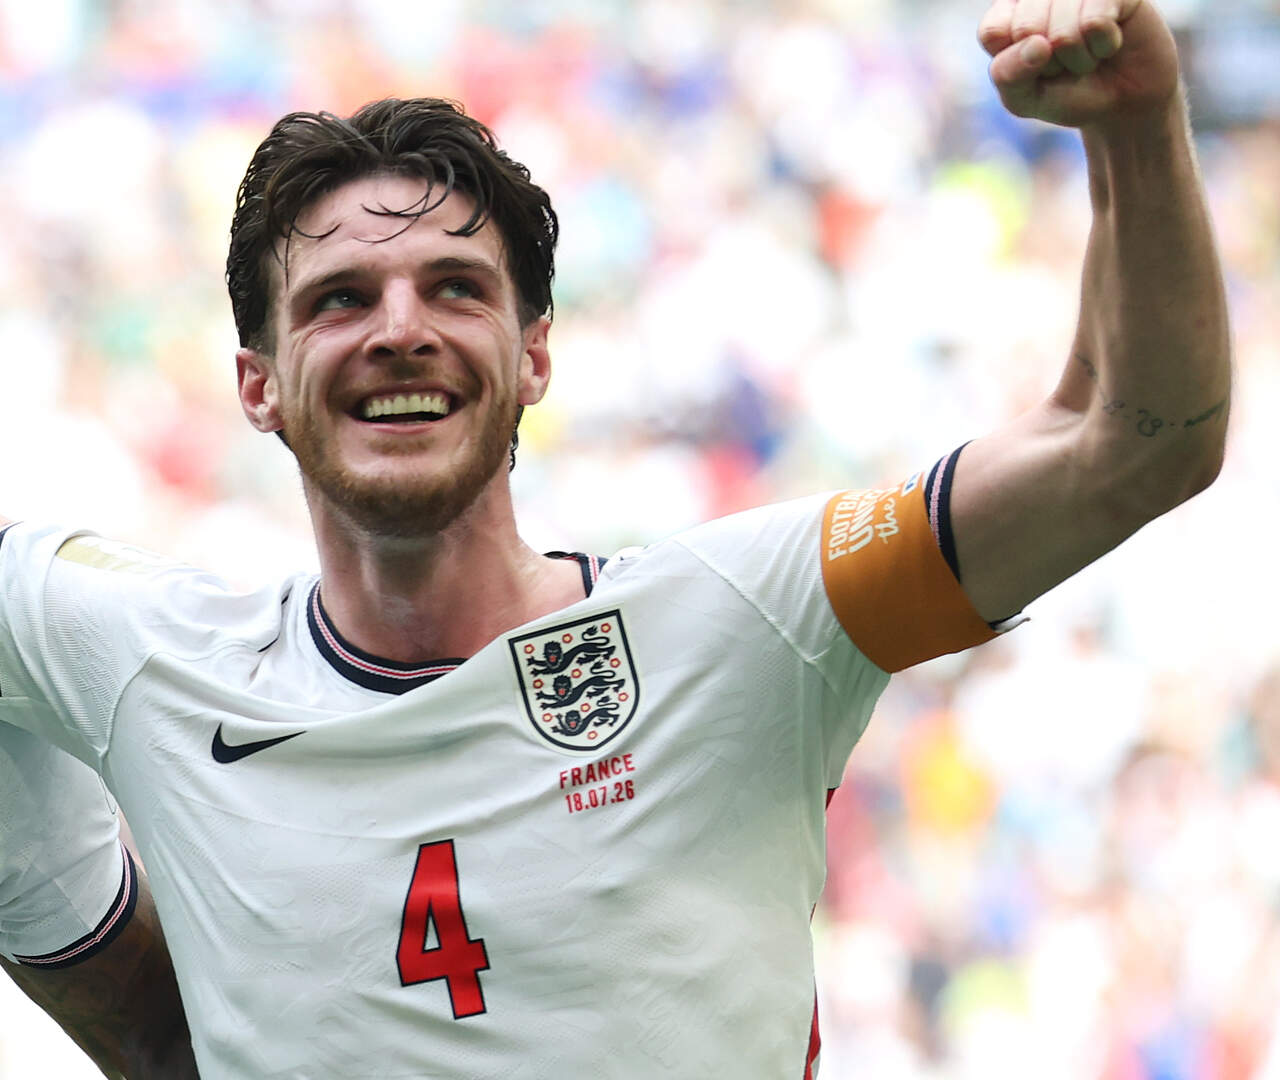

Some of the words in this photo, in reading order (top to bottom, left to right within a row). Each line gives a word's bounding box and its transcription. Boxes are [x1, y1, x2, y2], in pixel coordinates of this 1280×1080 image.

[875, 497, 899, 544] the
[559, 754, 636, 789] FRANCE
[565, 780, 635, 813] 18.07.26
[396, 838, 491, 1020] 4
